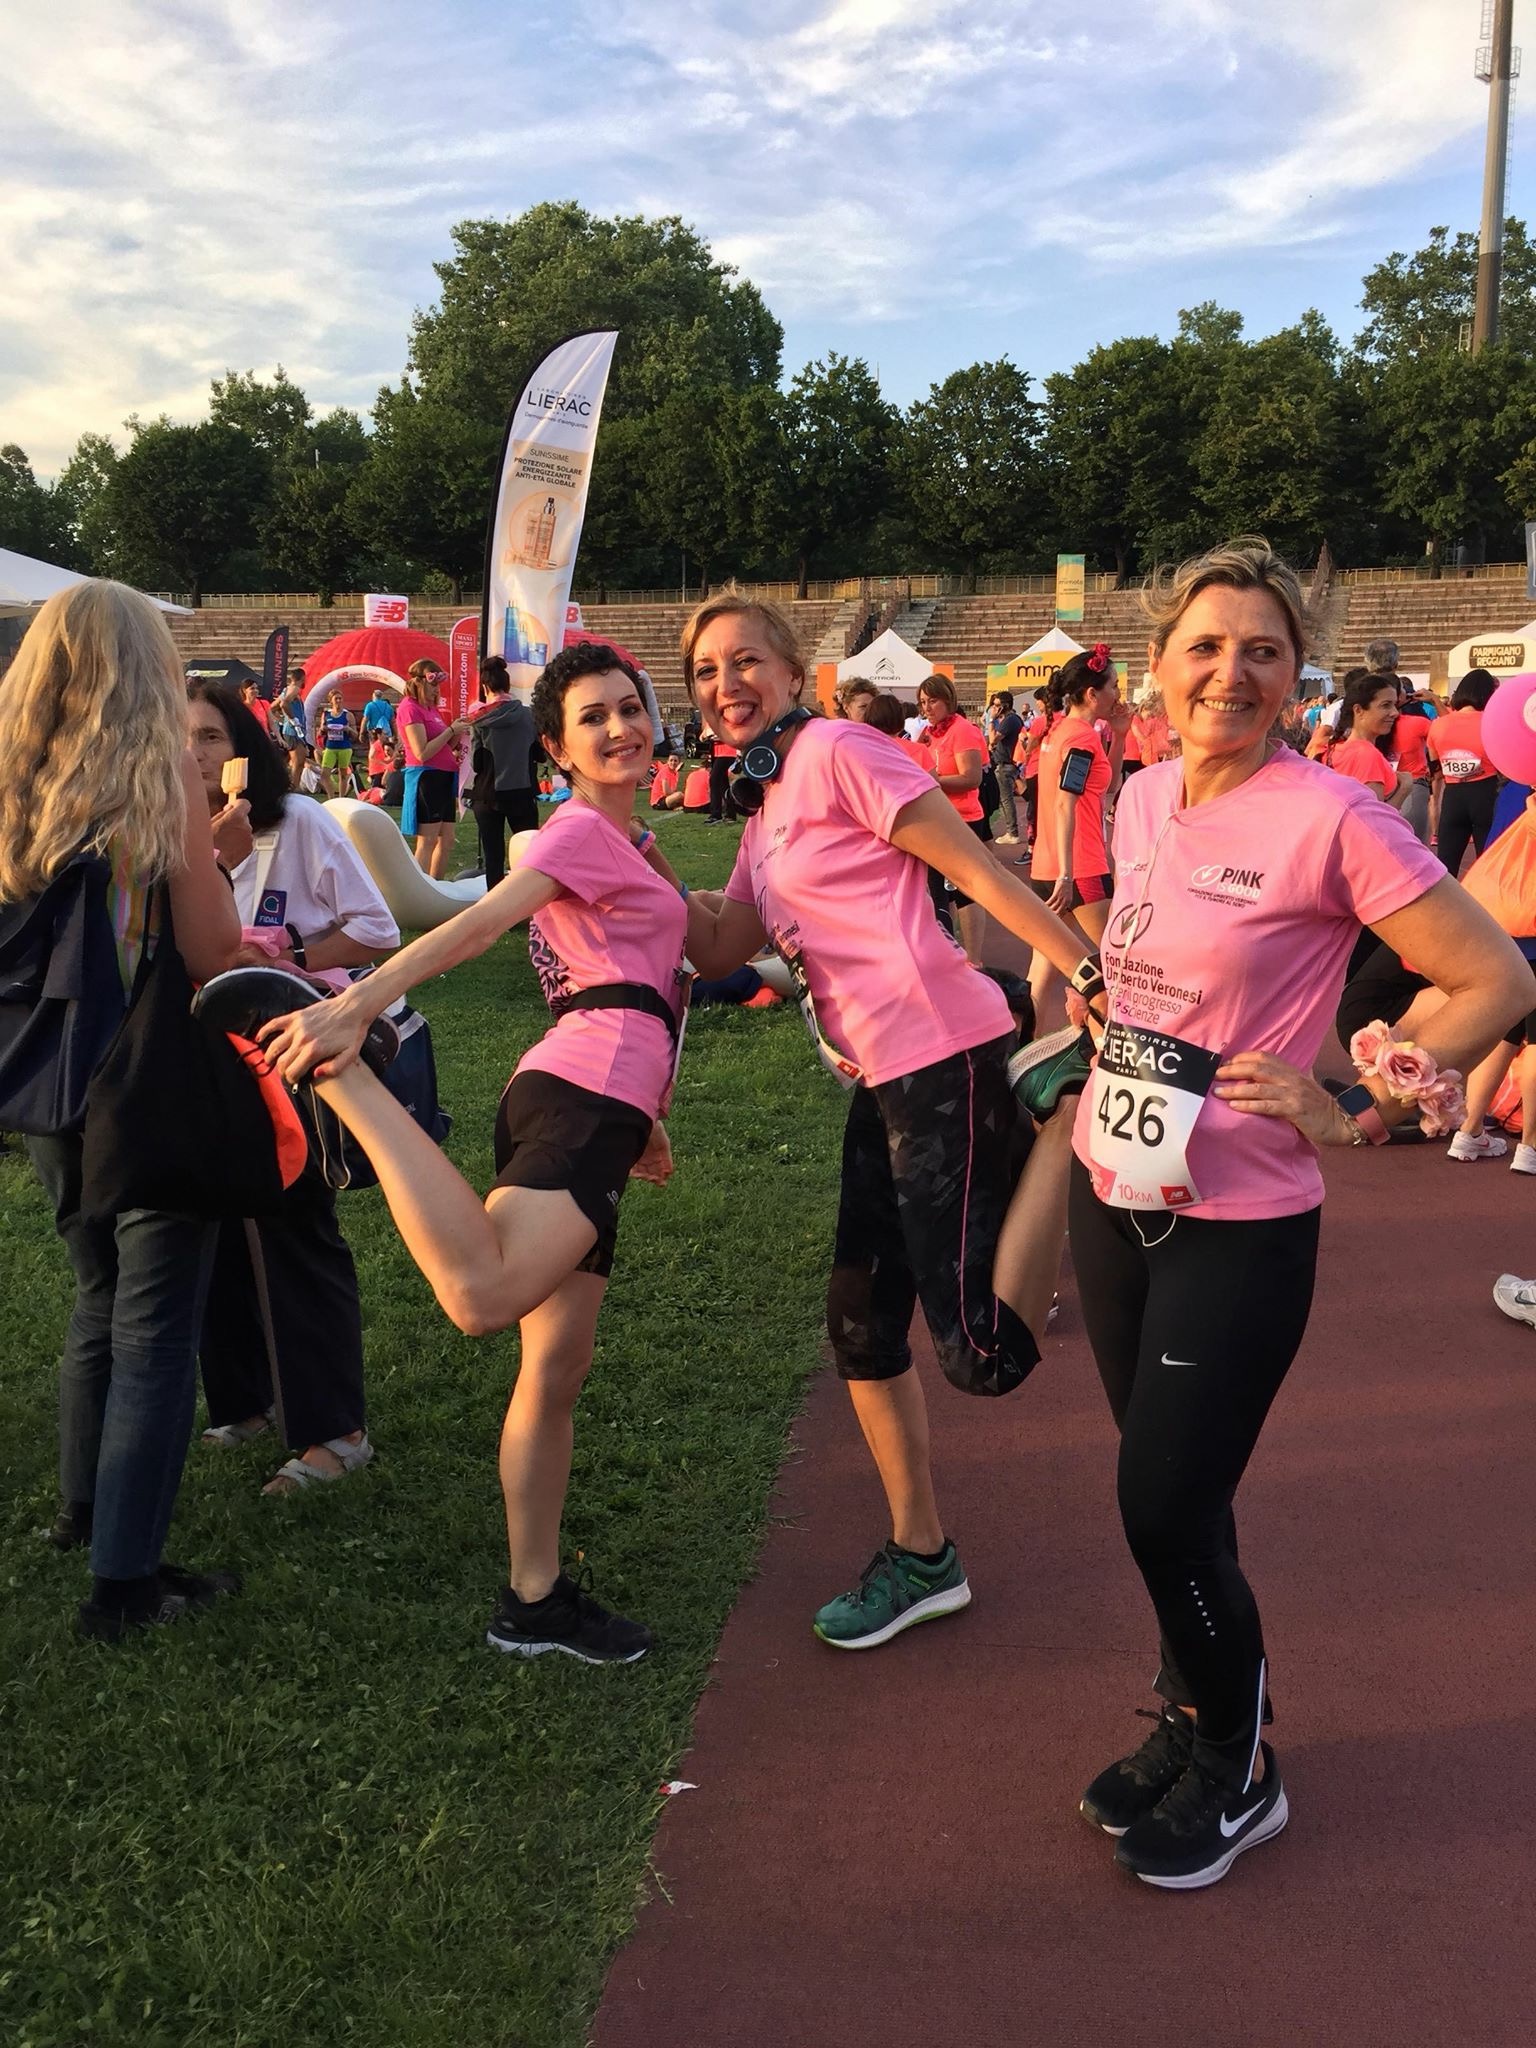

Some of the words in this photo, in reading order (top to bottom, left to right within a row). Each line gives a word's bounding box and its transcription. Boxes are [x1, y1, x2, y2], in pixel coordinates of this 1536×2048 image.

[527, 390, 591, 416] LIERAC
[529, 448, 569, 462] SUNISSIME
[514, 457, 555, 470] PROTEZIONE
[556, 464, 583, 475] SOLARE
[522, 466, 572, 480] ENERGIZZANTE
[546, 476, 576, 488] GLOBALE
[1472, 645, 1521, 657] PARMIGIANO
[1476, 656, 1516, 667] REGGIANO
[1017, 664, 1061, 678] mim
[459, 652, 469, 720] maxisport.com
[1444, 761, 1476, 773] 1887
[1220, 867, 1265, 890] PINK
[1227, 883, 1261, 898] GOOD
[259, 915, 279, 924] FIDAL
[1150, 977, 1203, 1004] Veronesi
[1132, 992, 1182, 1015] progresso
[1120, 1003, 1160, 1025] scienze
[1104, 1036, 1182, 1075] LIERAC
[1115, 1066, 1138, 1076] PARIS
[1098, 1084, 1169, 1147] 426
